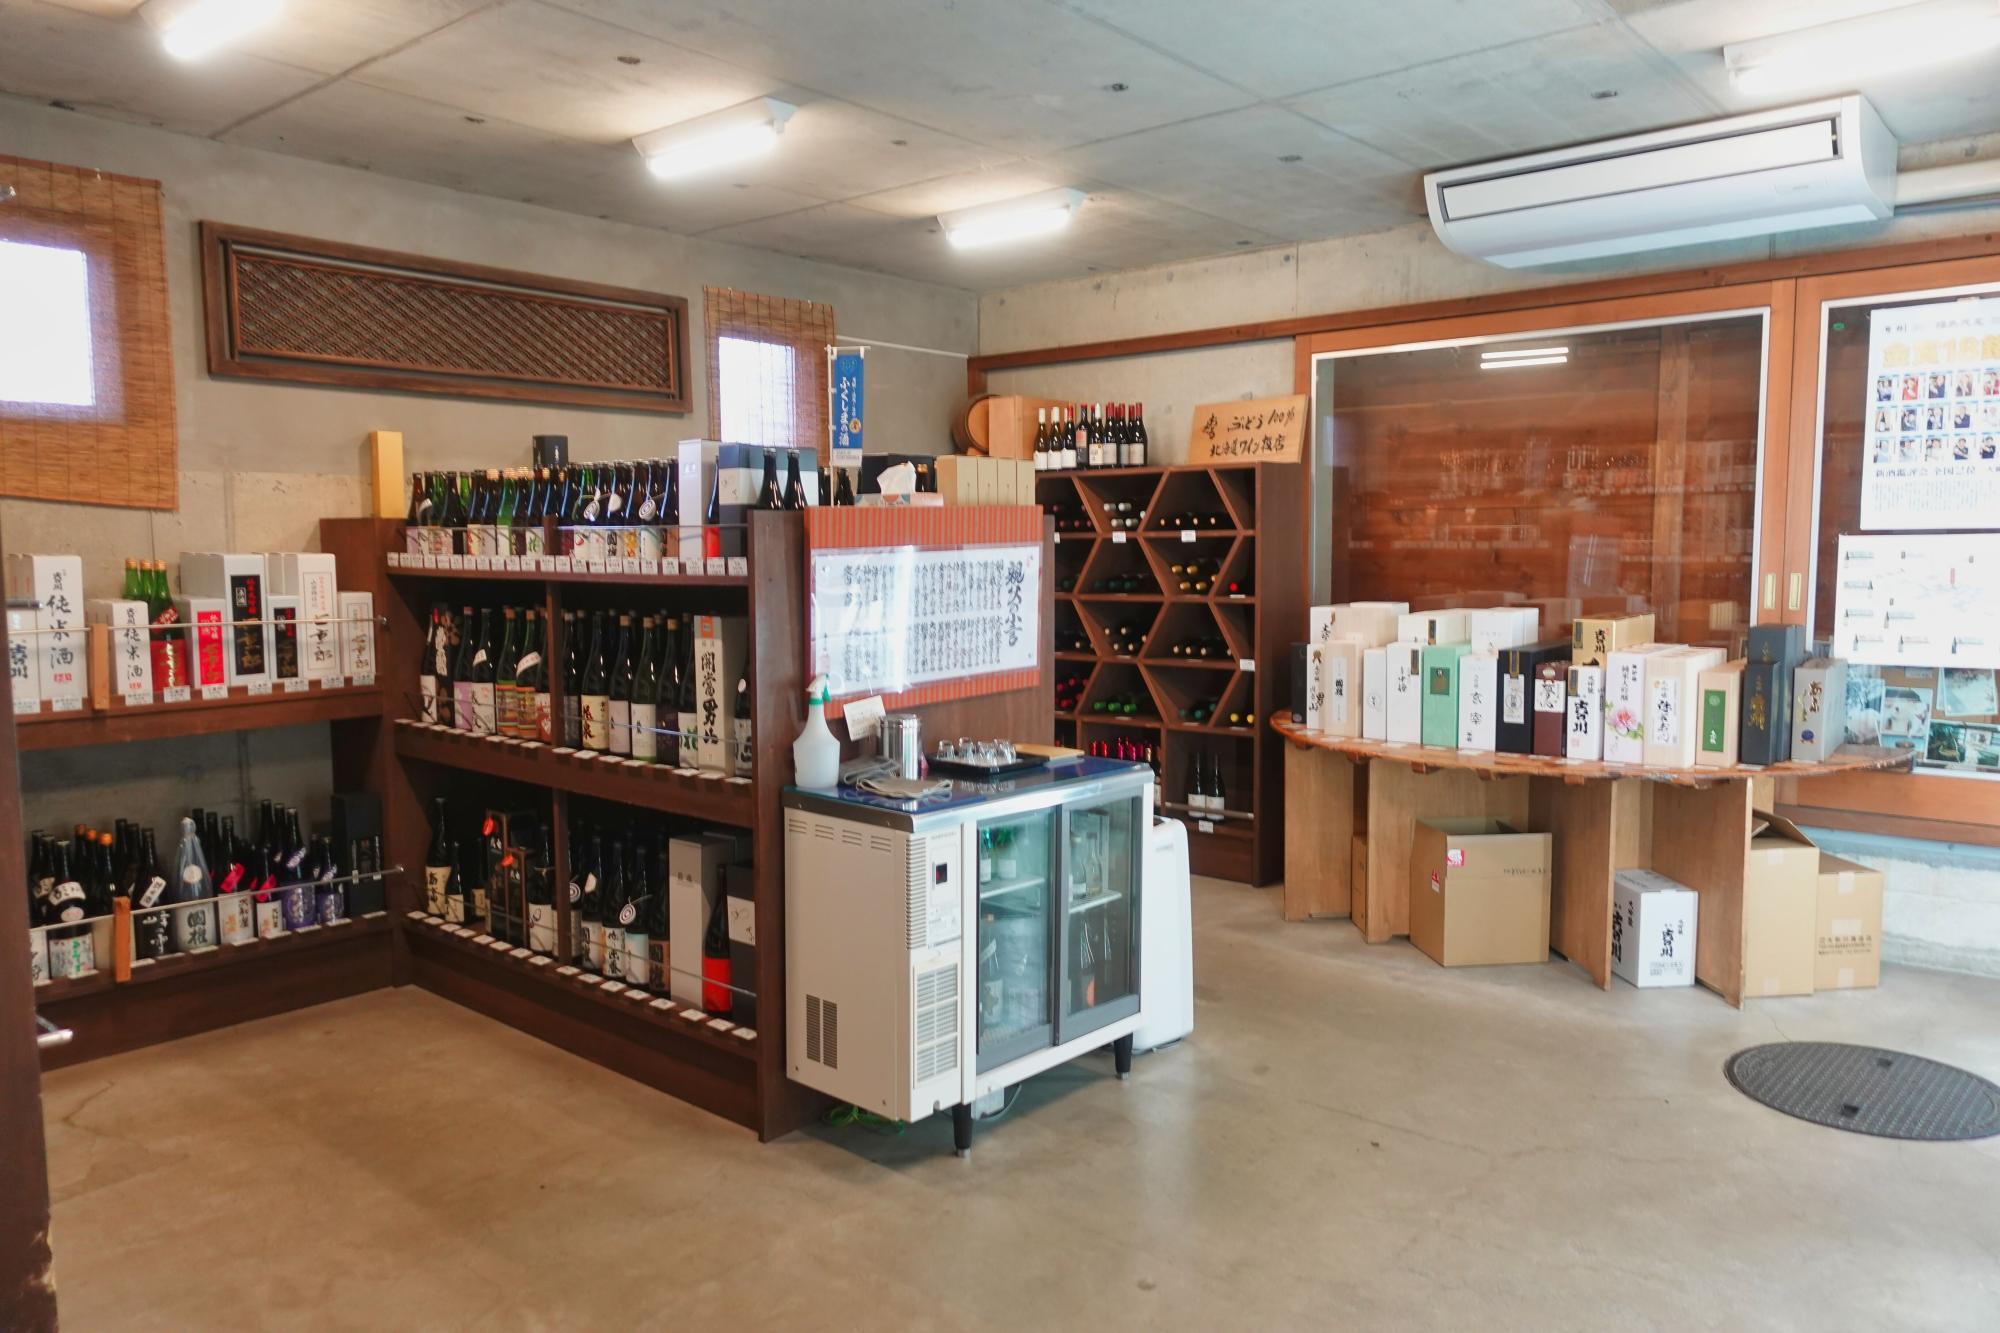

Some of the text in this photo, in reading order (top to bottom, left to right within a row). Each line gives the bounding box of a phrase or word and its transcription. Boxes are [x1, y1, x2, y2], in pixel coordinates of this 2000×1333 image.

[1003, 560, 1024, 647] 親父の小言
